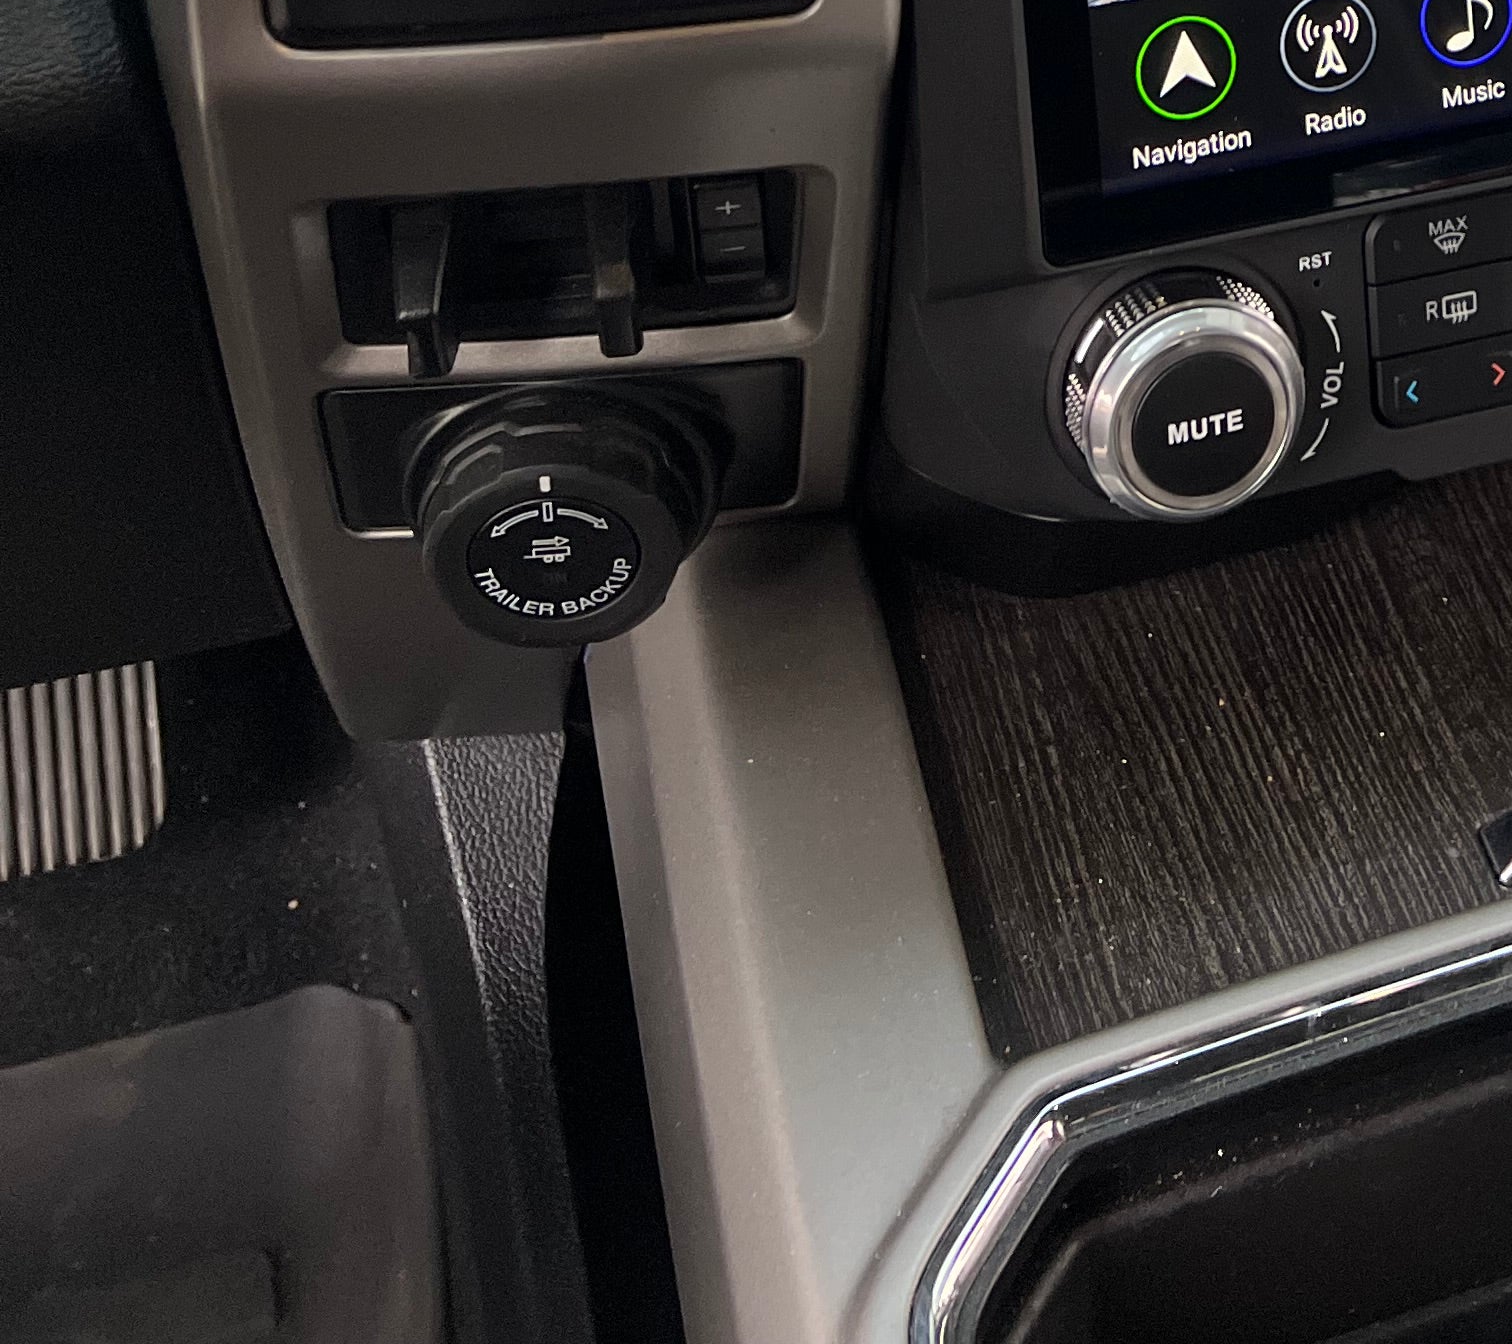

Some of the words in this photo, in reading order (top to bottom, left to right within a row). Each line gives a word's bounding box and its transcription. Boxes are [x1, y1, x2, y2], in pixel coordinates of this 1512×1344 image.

[1441, 78, 1506, 109] Music
[1304, 106, 1367, 136] Radio
[1131, 128, 1252, 170] Navigation
[1428, 215, 1469, 238] MAX
[1298, 250, 1333, 272] RST
[1320, 359, 1346, 410] VOL
[1167, 408, 1245, 446] MUTE
[474, 567, 555, 617] TRAILER
[561, 557, 633, 616] BACKUP
